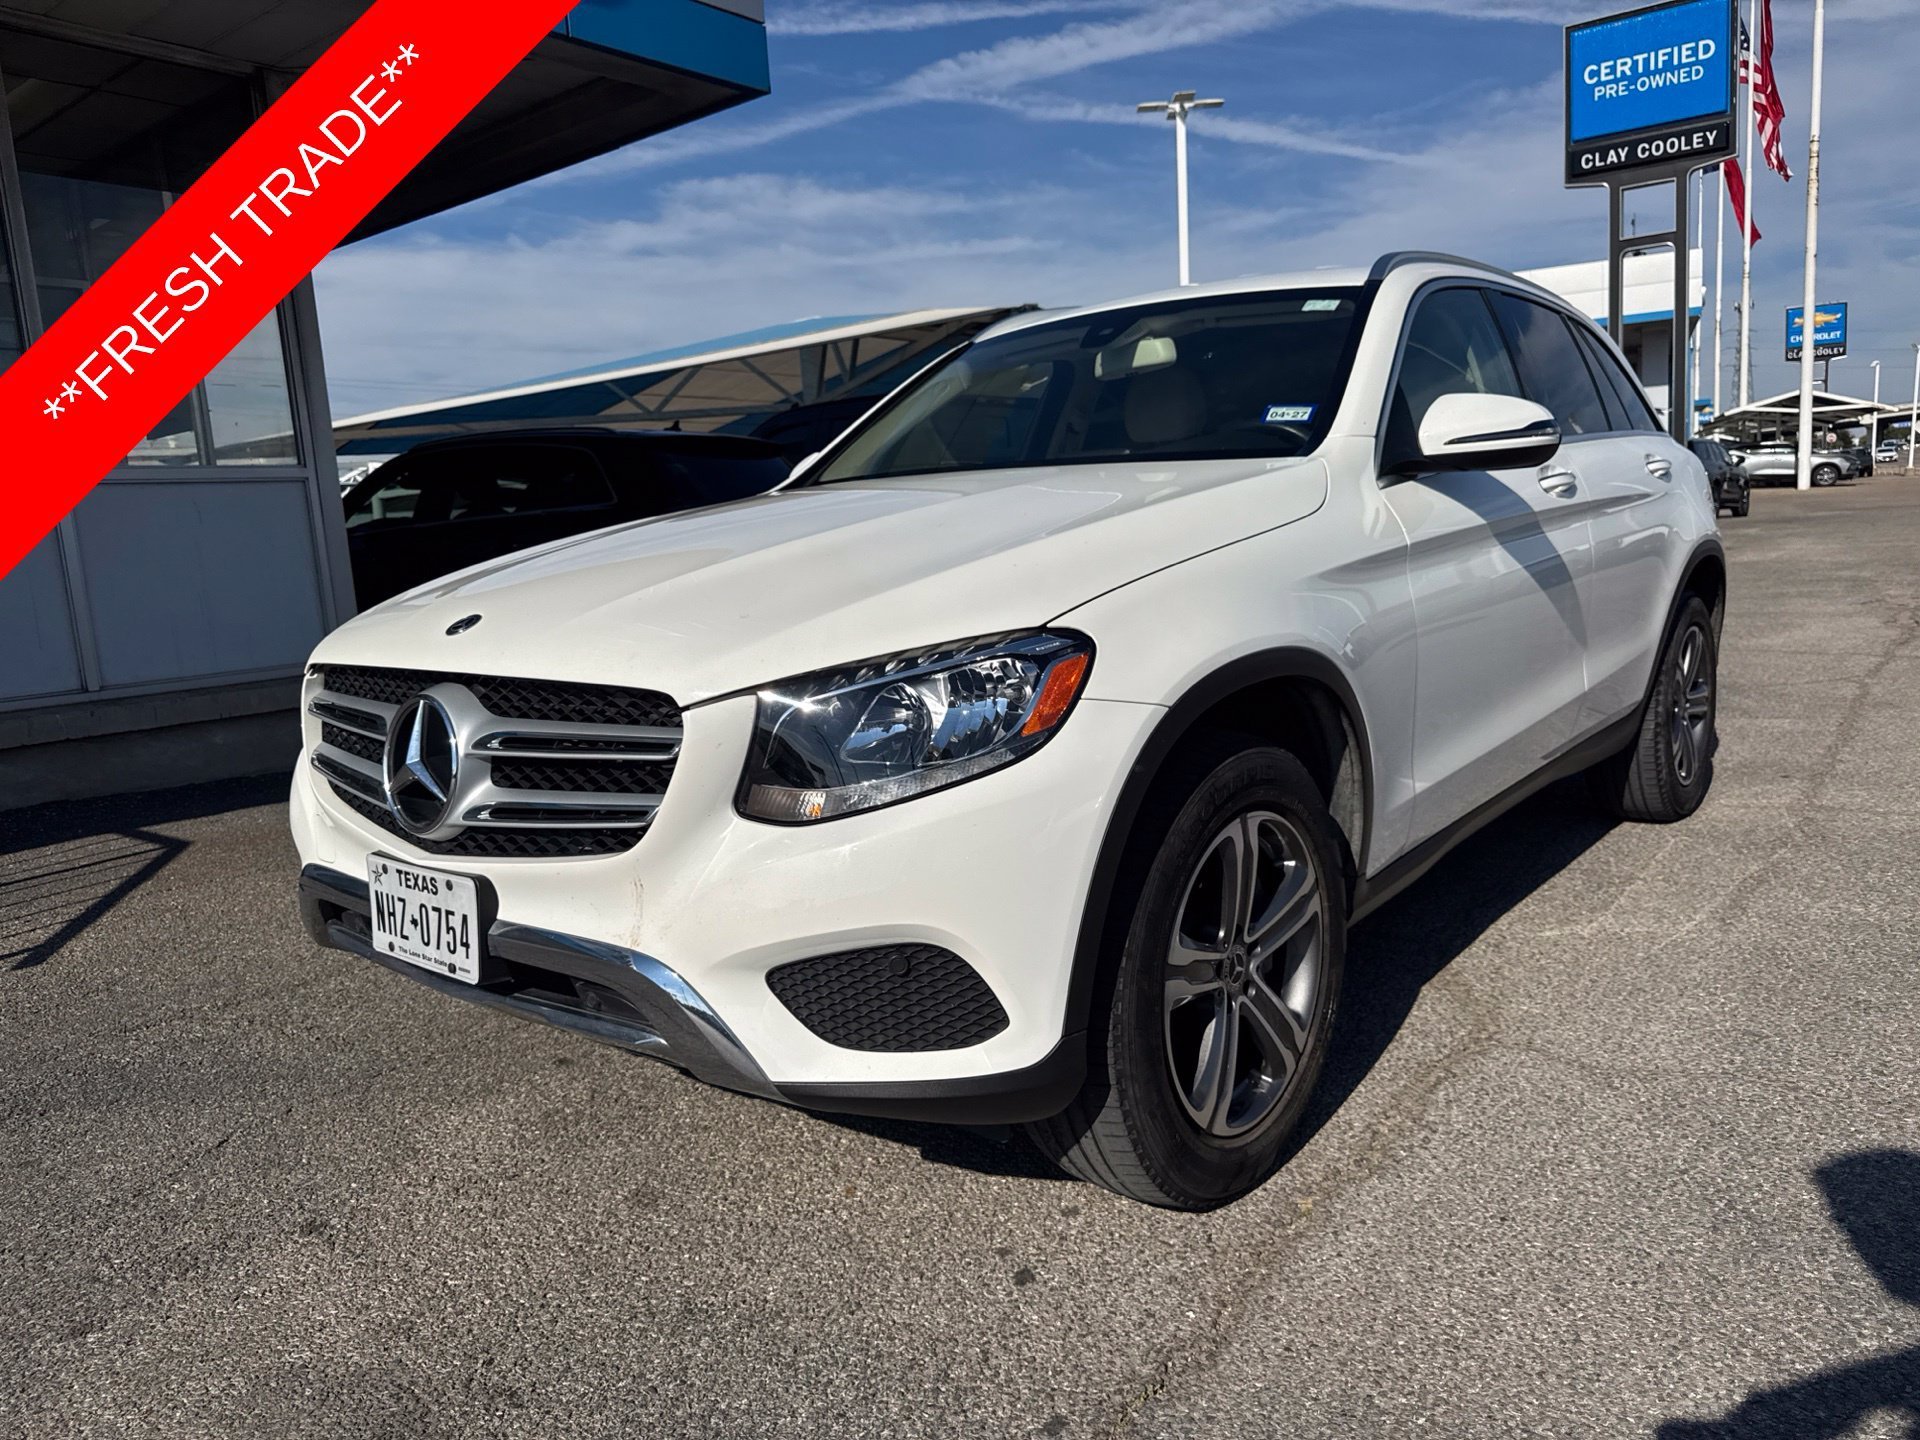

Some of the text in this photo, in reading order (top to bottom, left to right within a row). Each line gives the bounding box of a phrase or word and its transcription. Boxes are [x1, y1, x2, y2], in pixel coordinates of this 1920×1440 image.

[1583, 39, 1716, 85] CERTIFIED
[1594, 65, 1704, 102] PRE-OWNED
[1581, 130, 1718, 169] CLAY COOLEY
[395, 868, 439, 896] TEXAS
